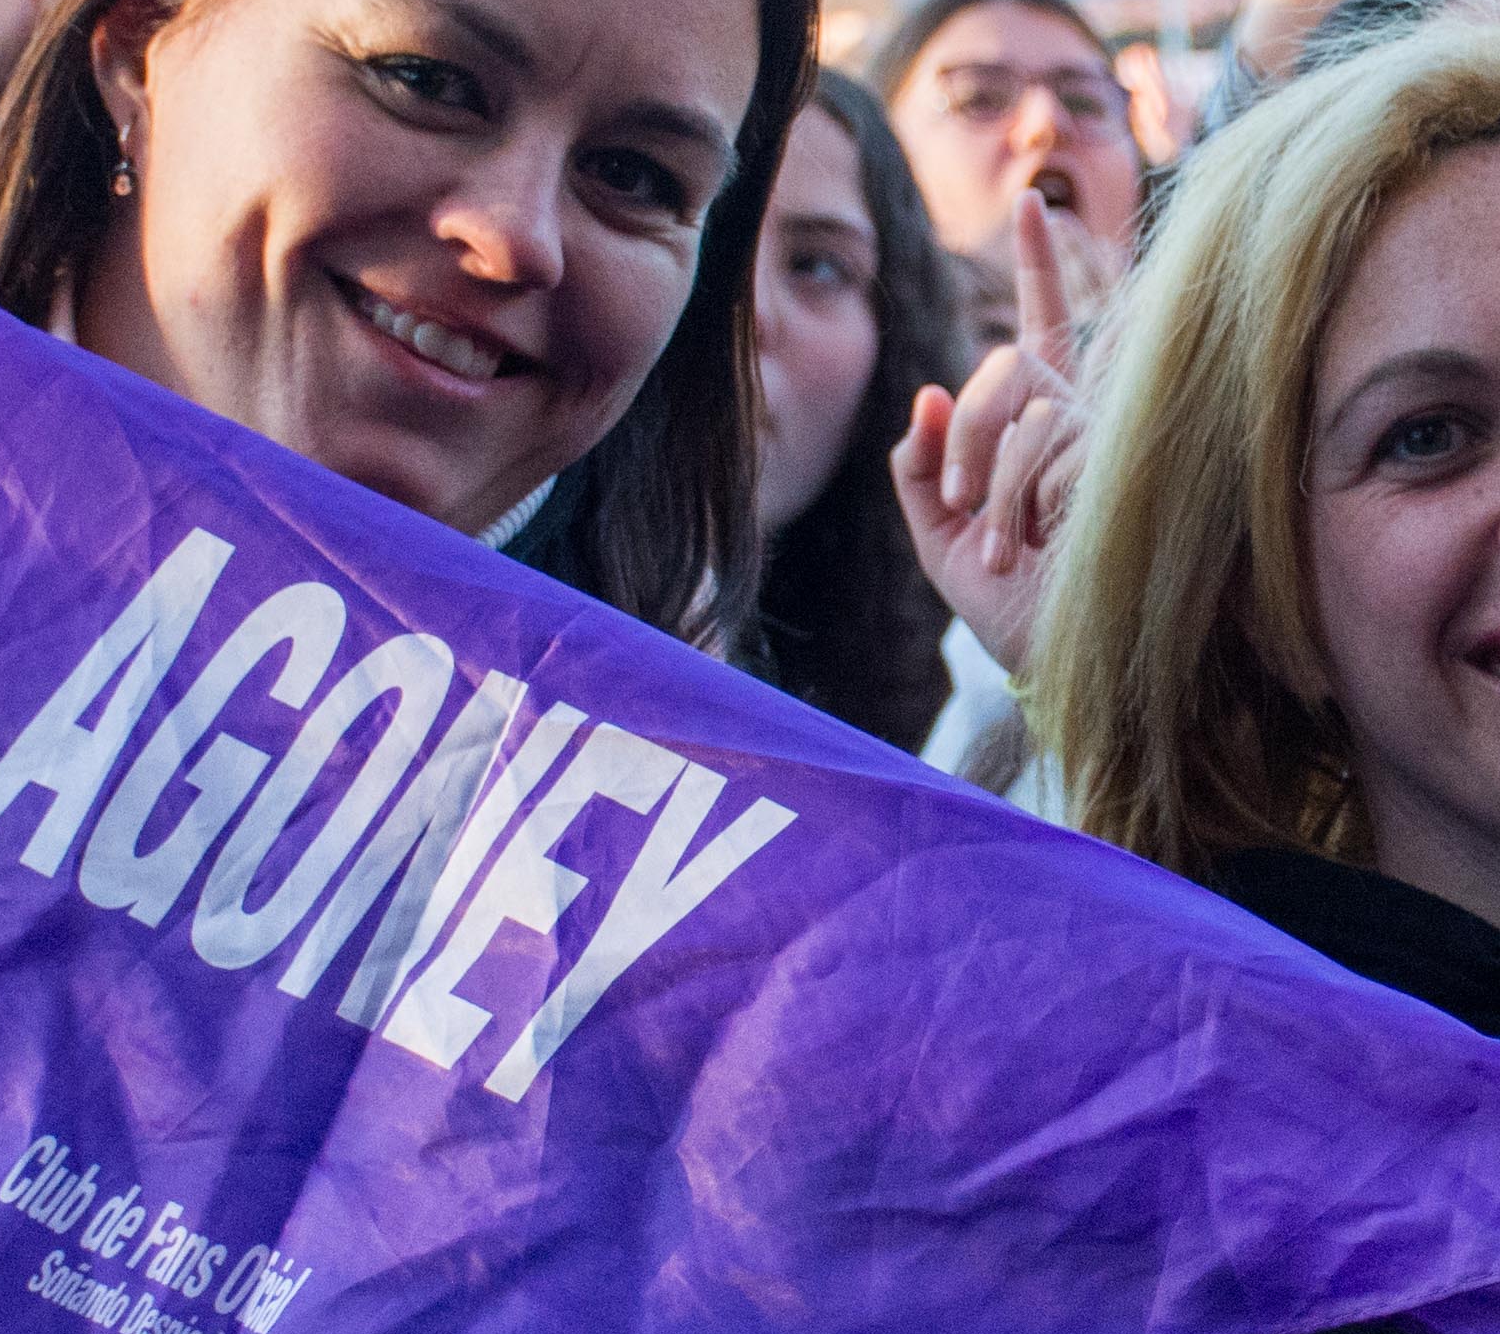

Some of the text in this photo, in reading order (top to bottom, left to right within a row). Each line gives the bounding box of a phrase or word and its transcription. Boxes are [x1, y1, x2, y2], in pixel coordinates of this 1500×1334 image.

[28, 1249, 130, 1328] Soñando
[80, 1184, 145, 1259] de
[126, 1201, 227, 1299] Fans
